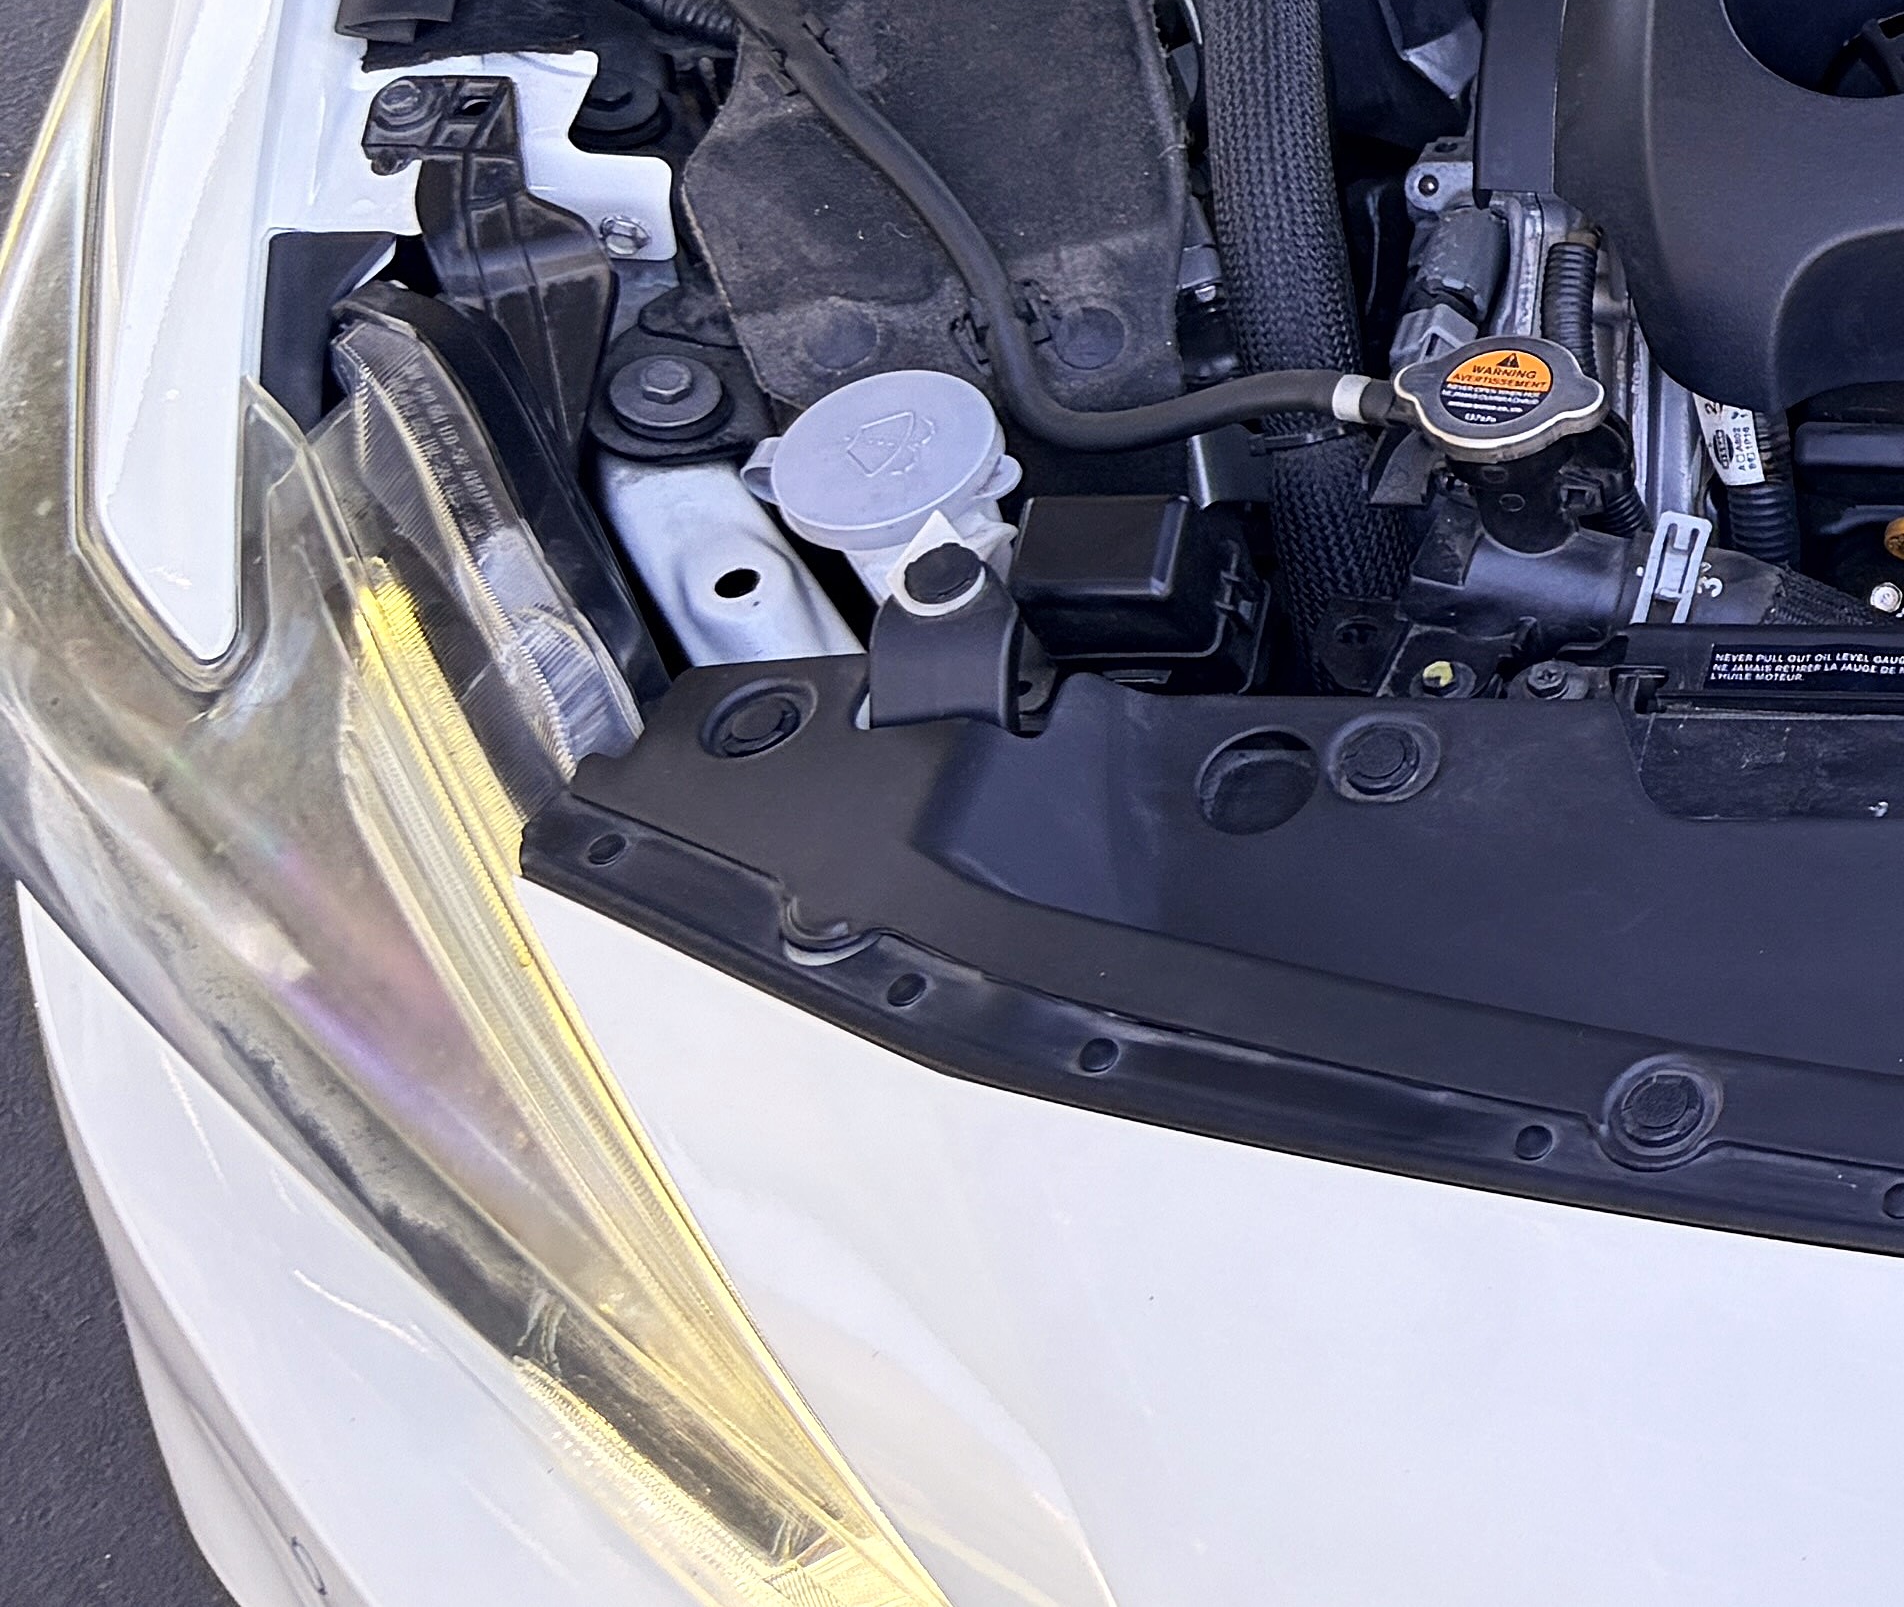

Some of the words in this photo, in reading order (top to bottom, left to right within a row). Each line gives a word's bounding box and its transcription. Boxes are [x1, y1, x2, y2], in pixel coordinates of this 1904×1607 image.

[1472, 365, 1537, 379] WARNING
[1453, 373, 1548, 388] AVERTISSEMENT
[1715, 653, 1753, 662] NEVER
[1755, 654, 1784, 663] PULL
[1787, 654, 1812, 663] OUT
[1814, 653, 1832, 662] OIL
[1836, 652, 1869, 663] LEVEL
[1713, 664, 1728, 672] NE
[1731, 663, 1772, 672] JAMAIS
[1774, 664, 1822, 673] RETIRER
[1824, 663, 1838, 672] LA
[1840, 663, 1878, 674] JAUGE
[1880, 666, 1896, 675] DE
[1754, 673, 1805, 681] MOTEUR.
